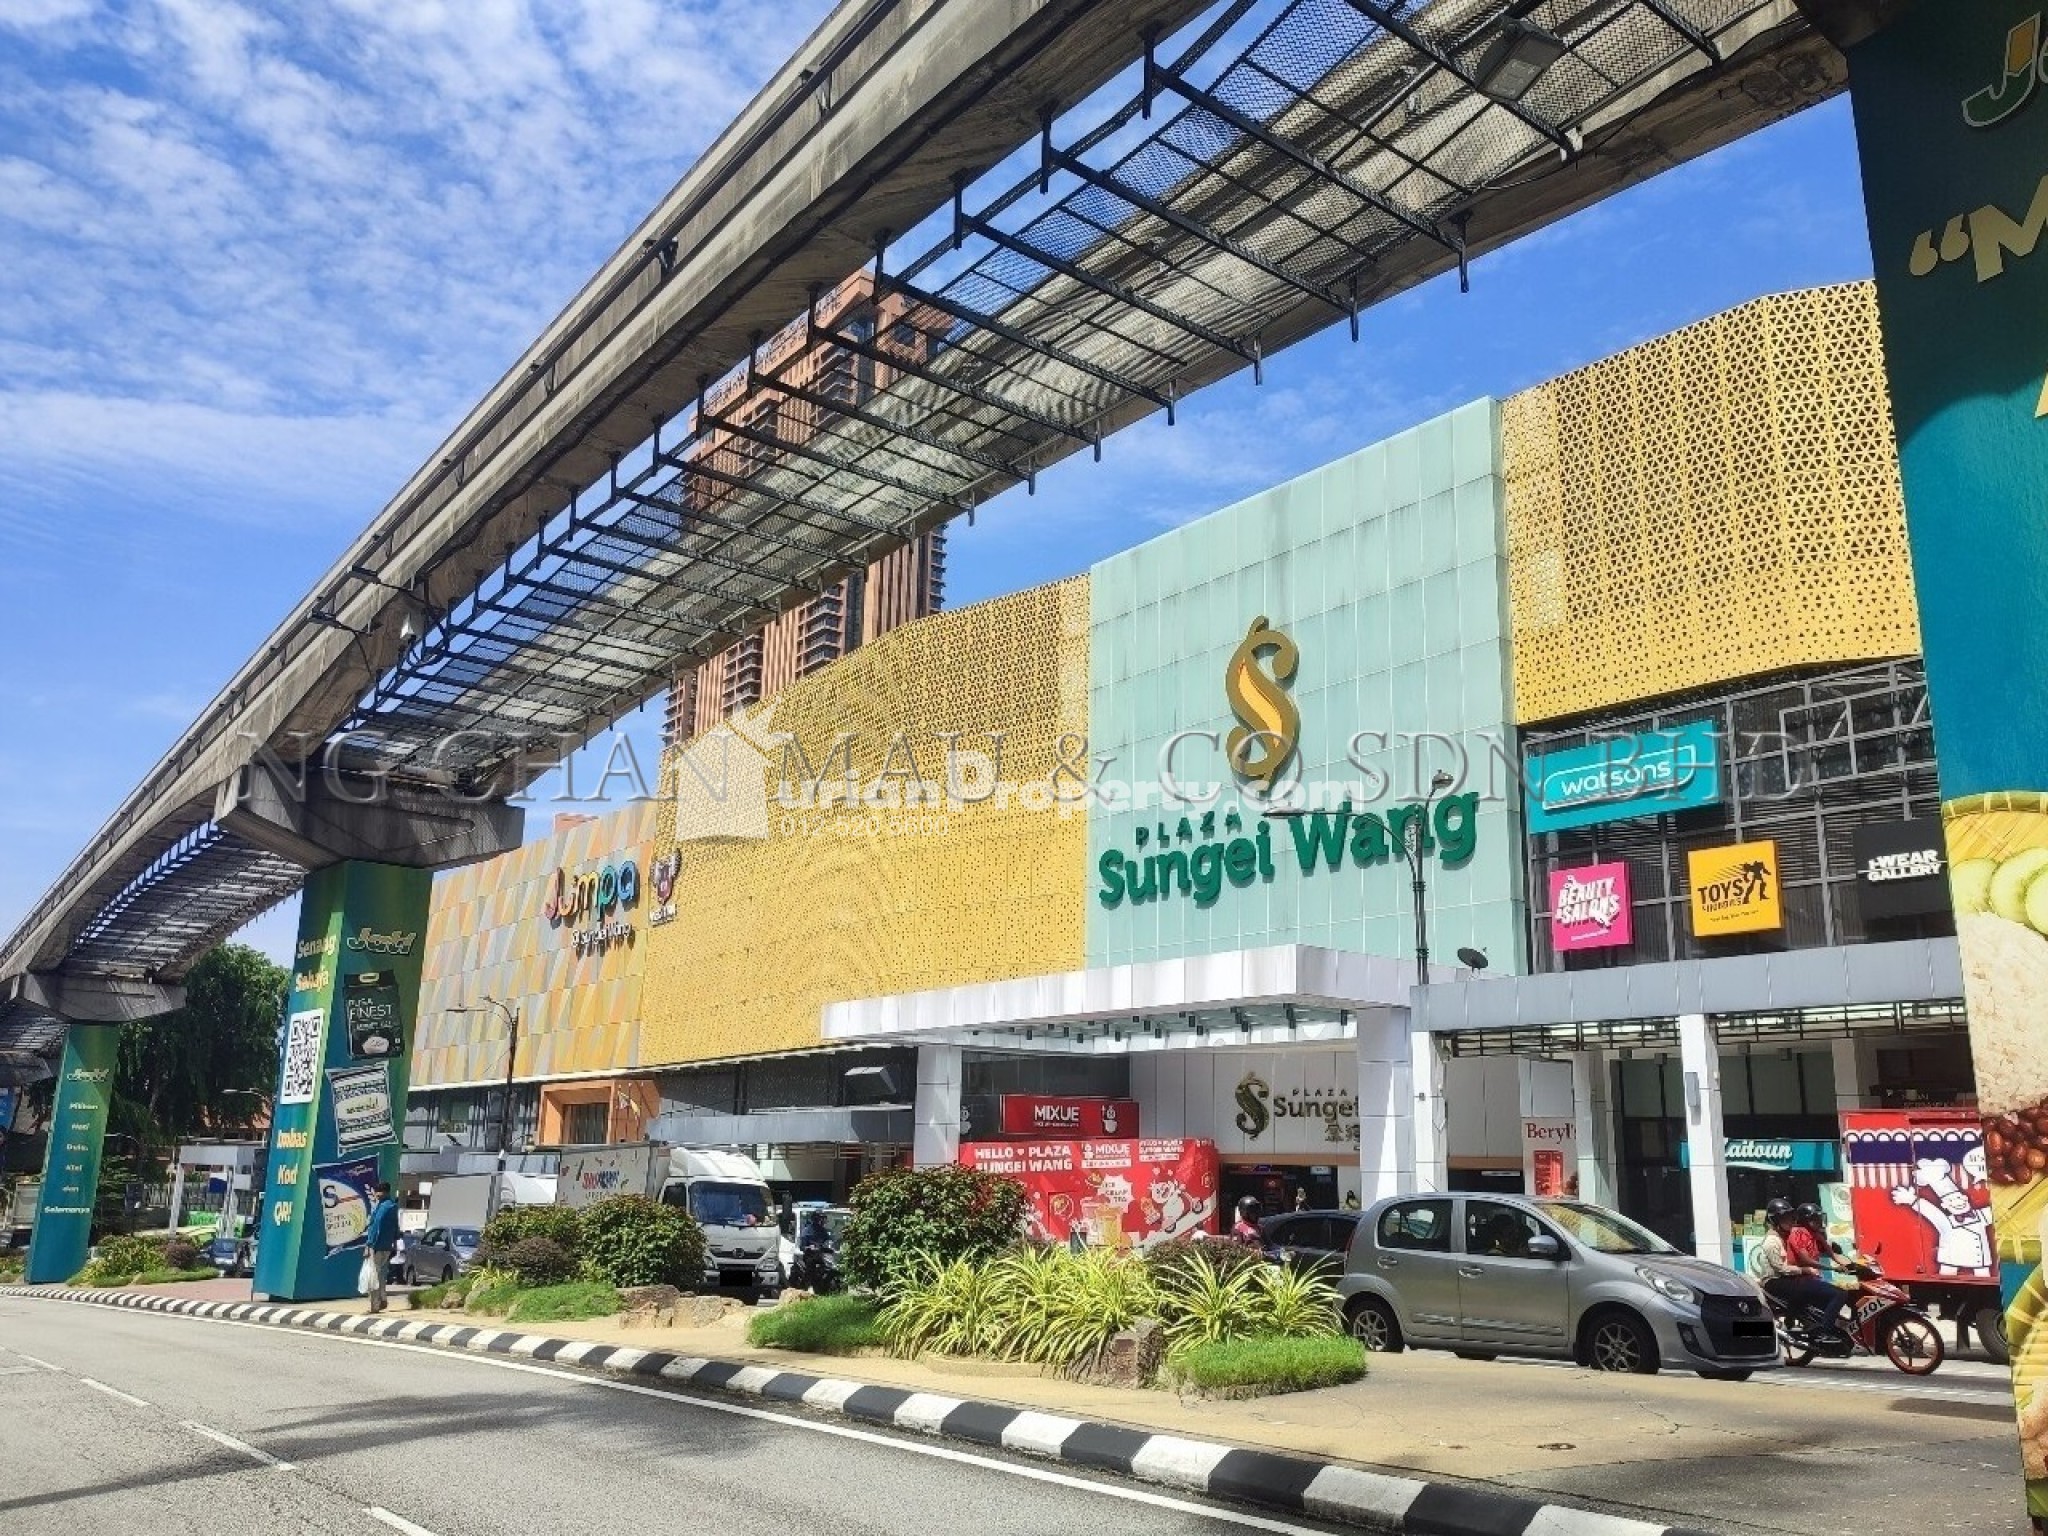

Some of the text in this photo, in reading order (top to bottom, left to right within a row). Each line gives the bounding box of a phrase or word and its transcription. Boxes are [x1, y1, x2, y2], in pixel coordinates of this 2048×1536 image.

[1560, 760, 1673, 797] watsons
[1135, 808, 1243, 849] PLAZA
[1098, 790, 1480, 908] Sungei Wang
[1867, 863, 1941, 882] GALLERY
[544, 860, 637, 921] Jumpa
[1558, 877, 1616, 908] BEAUTY
[1697, 878, 1744, 905] TOYS
[350, 1004, 392, 1020] FINEST
[1034, 1104, 1081, 1122] MIXUE
[974, 1145, 1073, 1160] HELLO PLAZA
[1029, 1159, 1073, 1172] WANG
